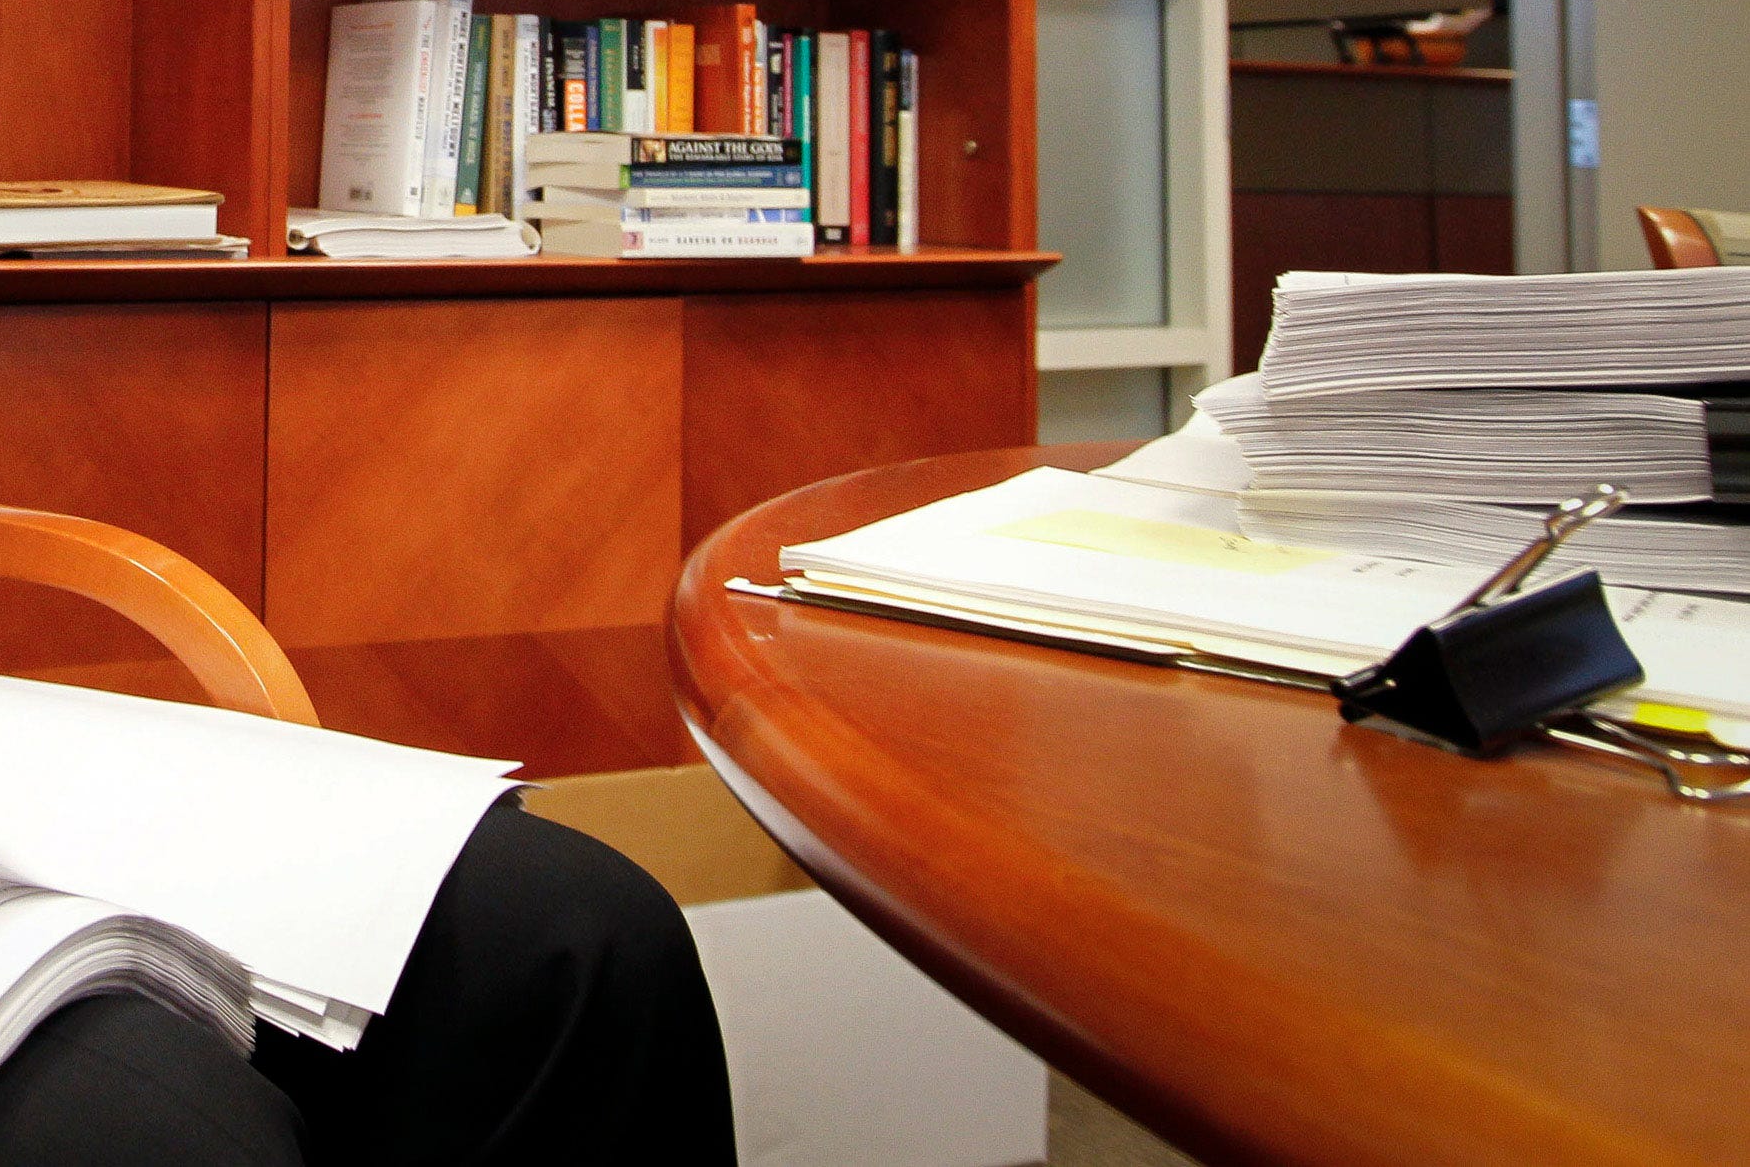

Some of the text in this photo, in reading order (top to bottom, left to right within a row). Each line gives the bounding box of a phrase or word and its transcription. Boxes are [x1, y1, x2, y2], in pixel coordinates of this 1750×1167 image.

[669, 142, 783, 155] AGAINST THE GODS
